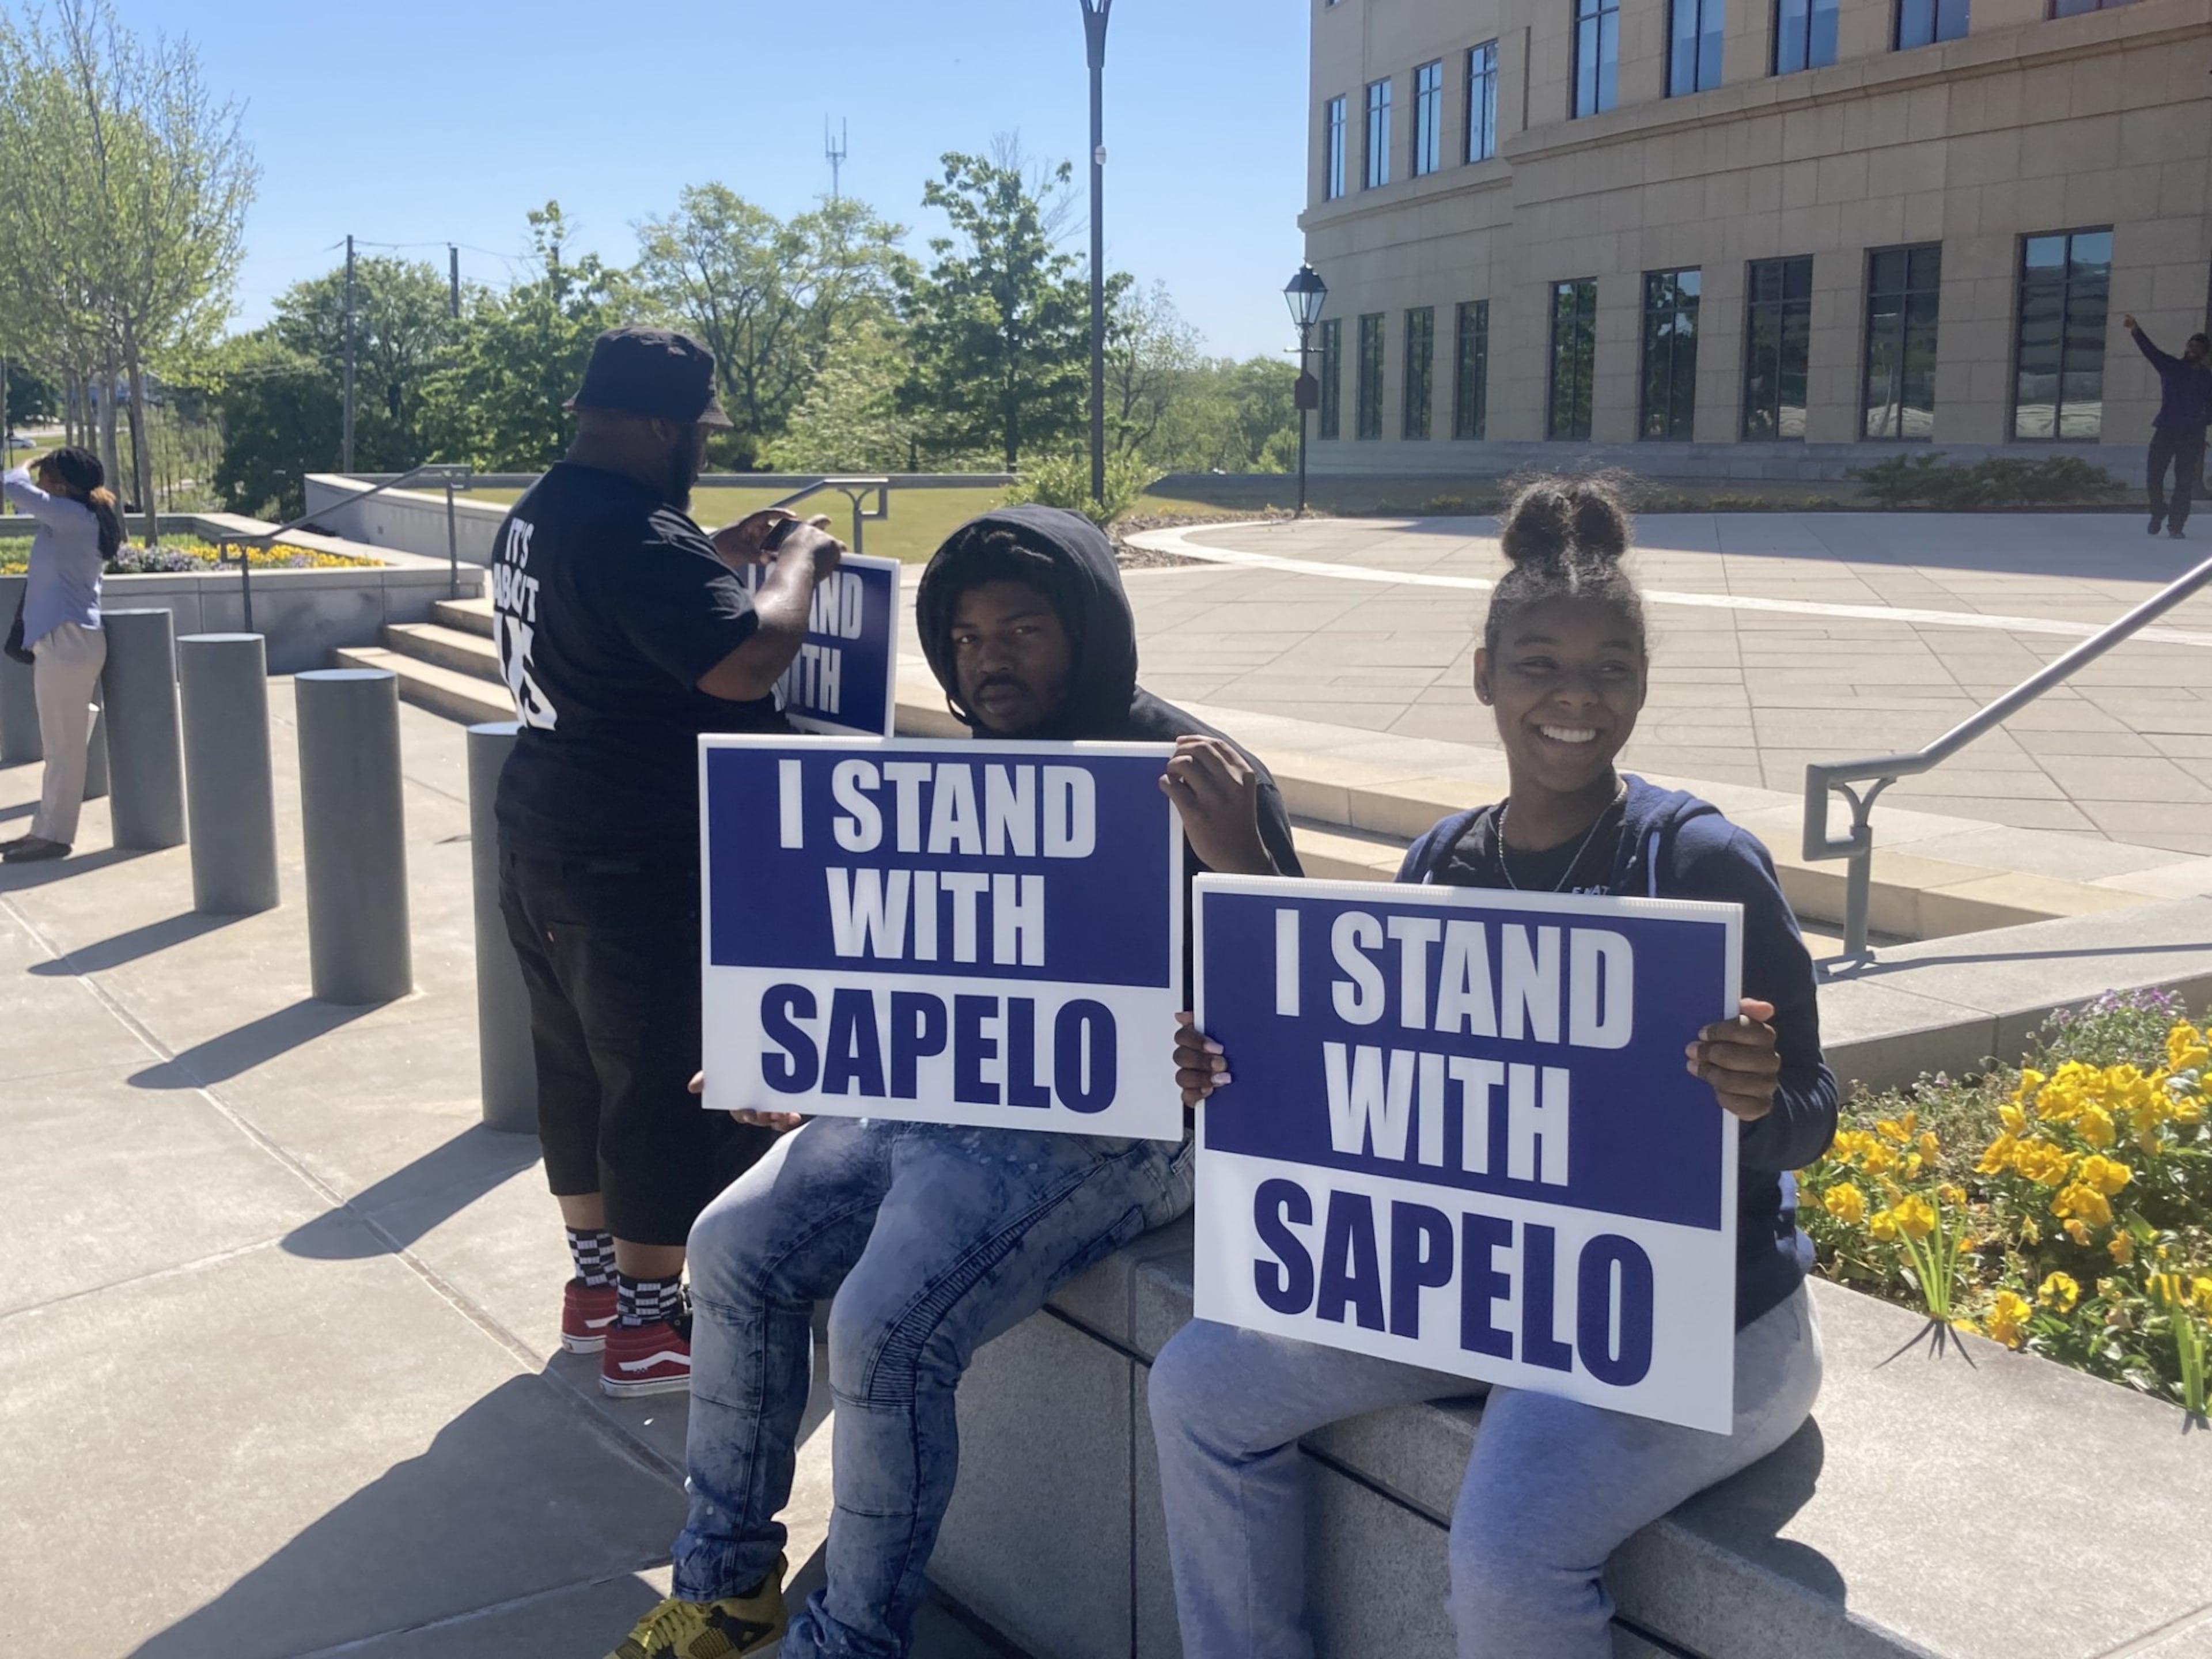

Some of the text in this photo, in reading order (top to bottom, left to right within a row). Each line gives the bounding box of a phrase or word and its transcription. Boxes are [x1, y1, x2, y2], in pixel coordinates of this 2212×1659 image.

[505, 517, 535, 569] IT'S
[779, 759, 1096, 858] I STAND
[825, 867, 1044, 967] WITH
[1275, 908, 1634, 1049] I STAND
[760, 983, 1117, 1114] SAPELO
[1323, 1041, 1570, 1187] WITH
[1253, 1178, 1654, 1387] SAPELO
